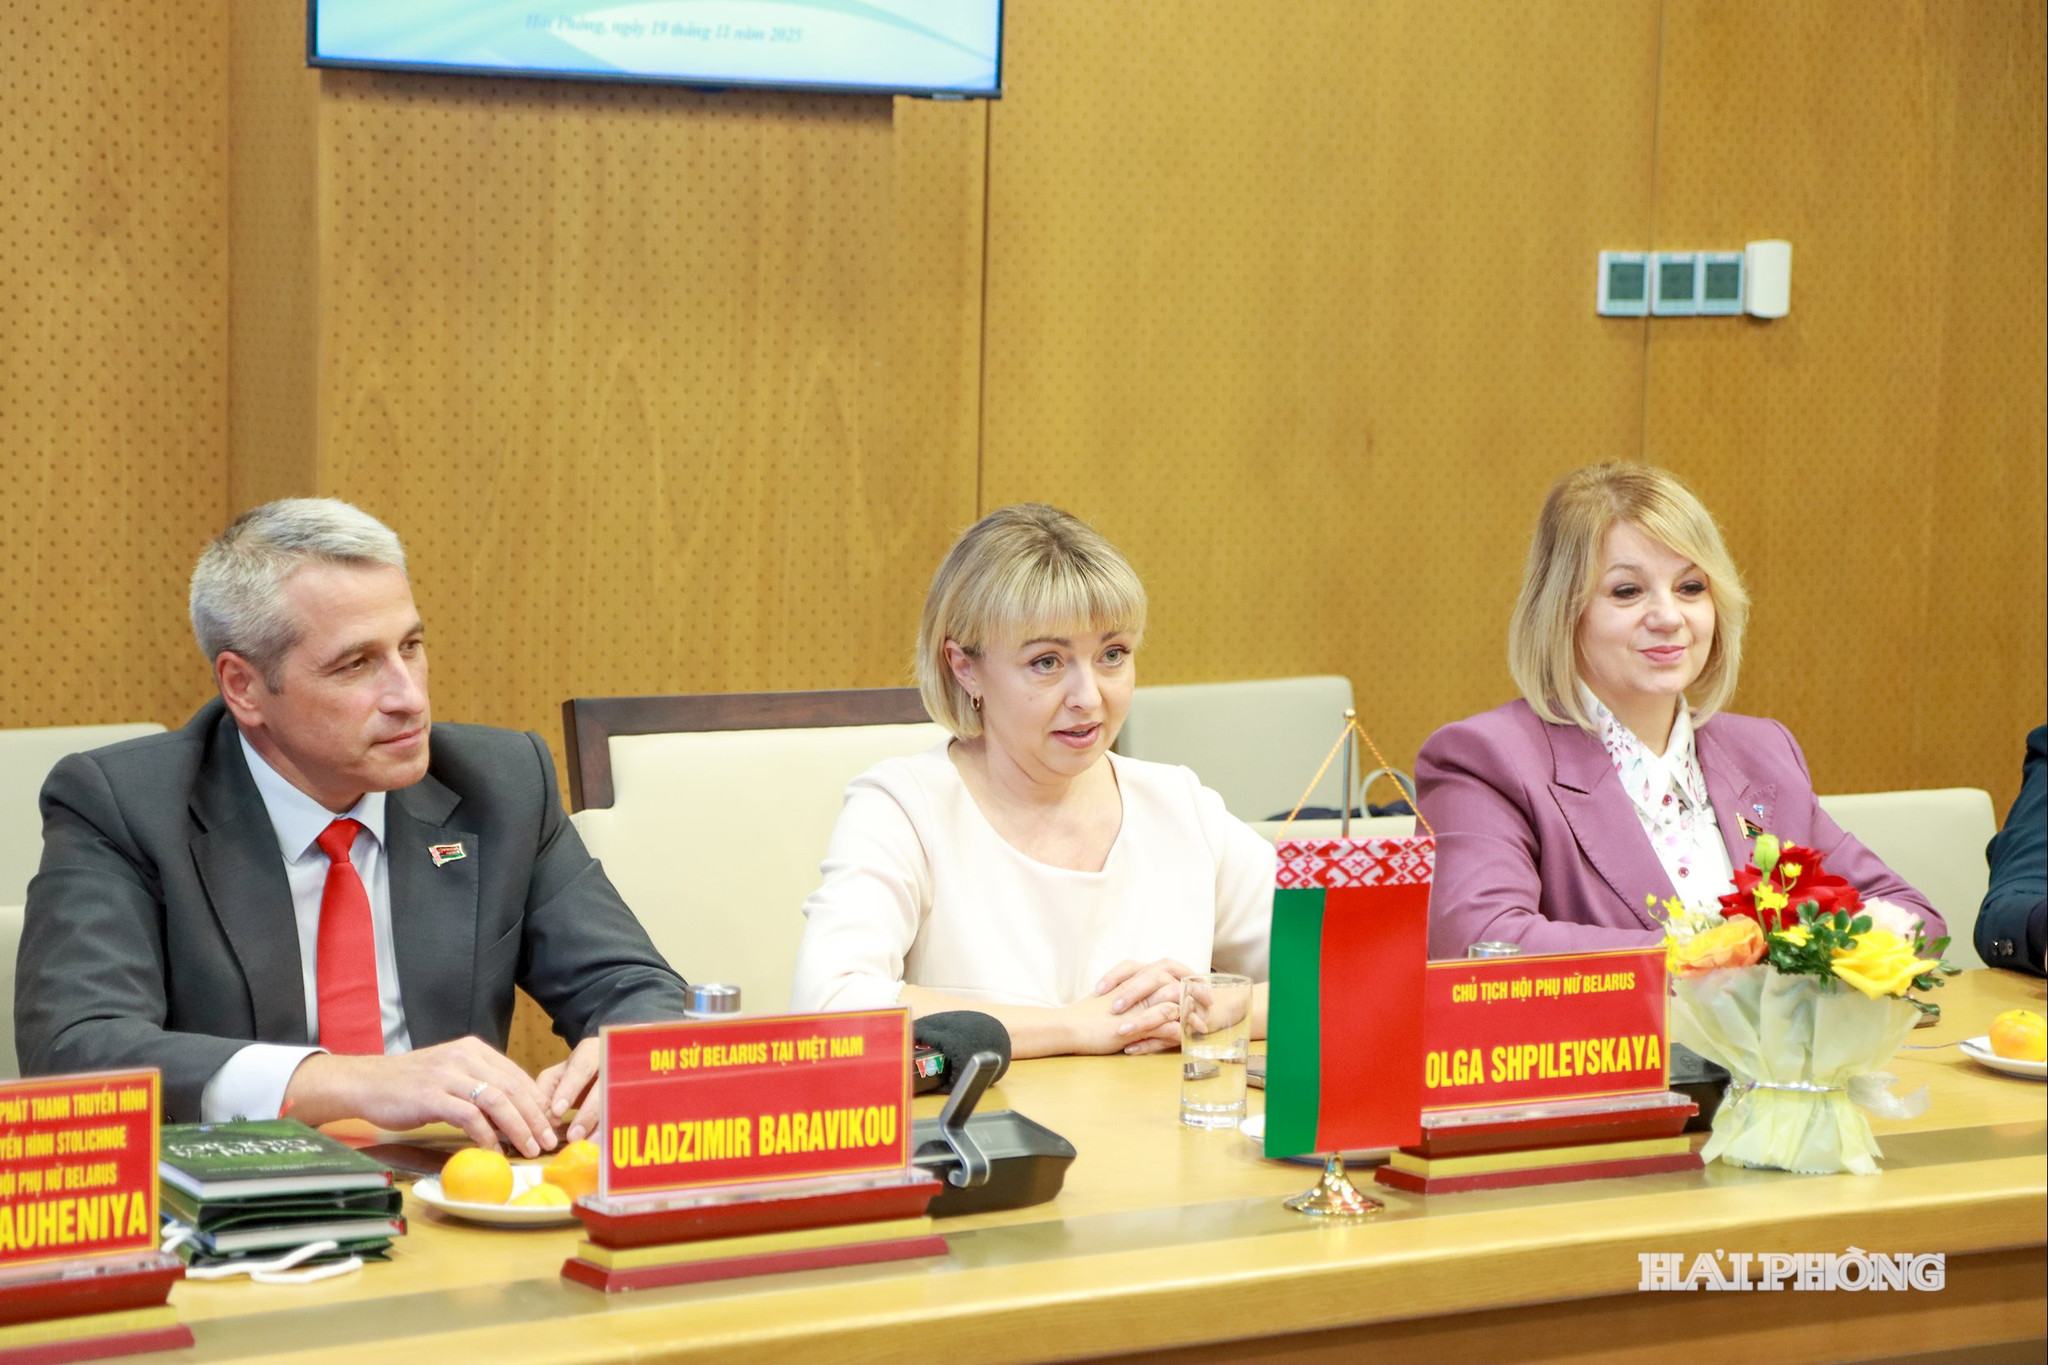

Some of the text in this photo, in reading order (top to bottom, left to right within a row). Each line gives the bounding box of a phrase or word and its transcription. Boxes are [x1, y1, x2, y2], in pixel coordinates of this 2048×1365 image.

[612, 19, 645, 38] ngày
[651, 20, 668, 35] 19
[670, 21, 712, 41] tháng
[716, 24, 730, 39] 11
[769, 27, 804, 42] 2025
[1452, 972, 1635, 1004] CHỦ TỊCH HỘI PHỤ NỮ BELARUS
[650, 1035, 864, 1075] ĐẠI SỨ BELARUS TẠI VIỆT NAM
[1425, 1034, 1661, 1089] OLGA SHPILEVSKAYA
[31, 1095, 70, 1121] THANH
[57, 1125, 127, 1155] STOLICHNOE
[612, 1105, 897, 1168] ULADZIMIR BARAVIKOU
[18, 1170, 42, 1198] PHỤ
[65, 1162, 117, 1189] BELARUS
[0, 1191, 148, 1250] AUHENIYA
